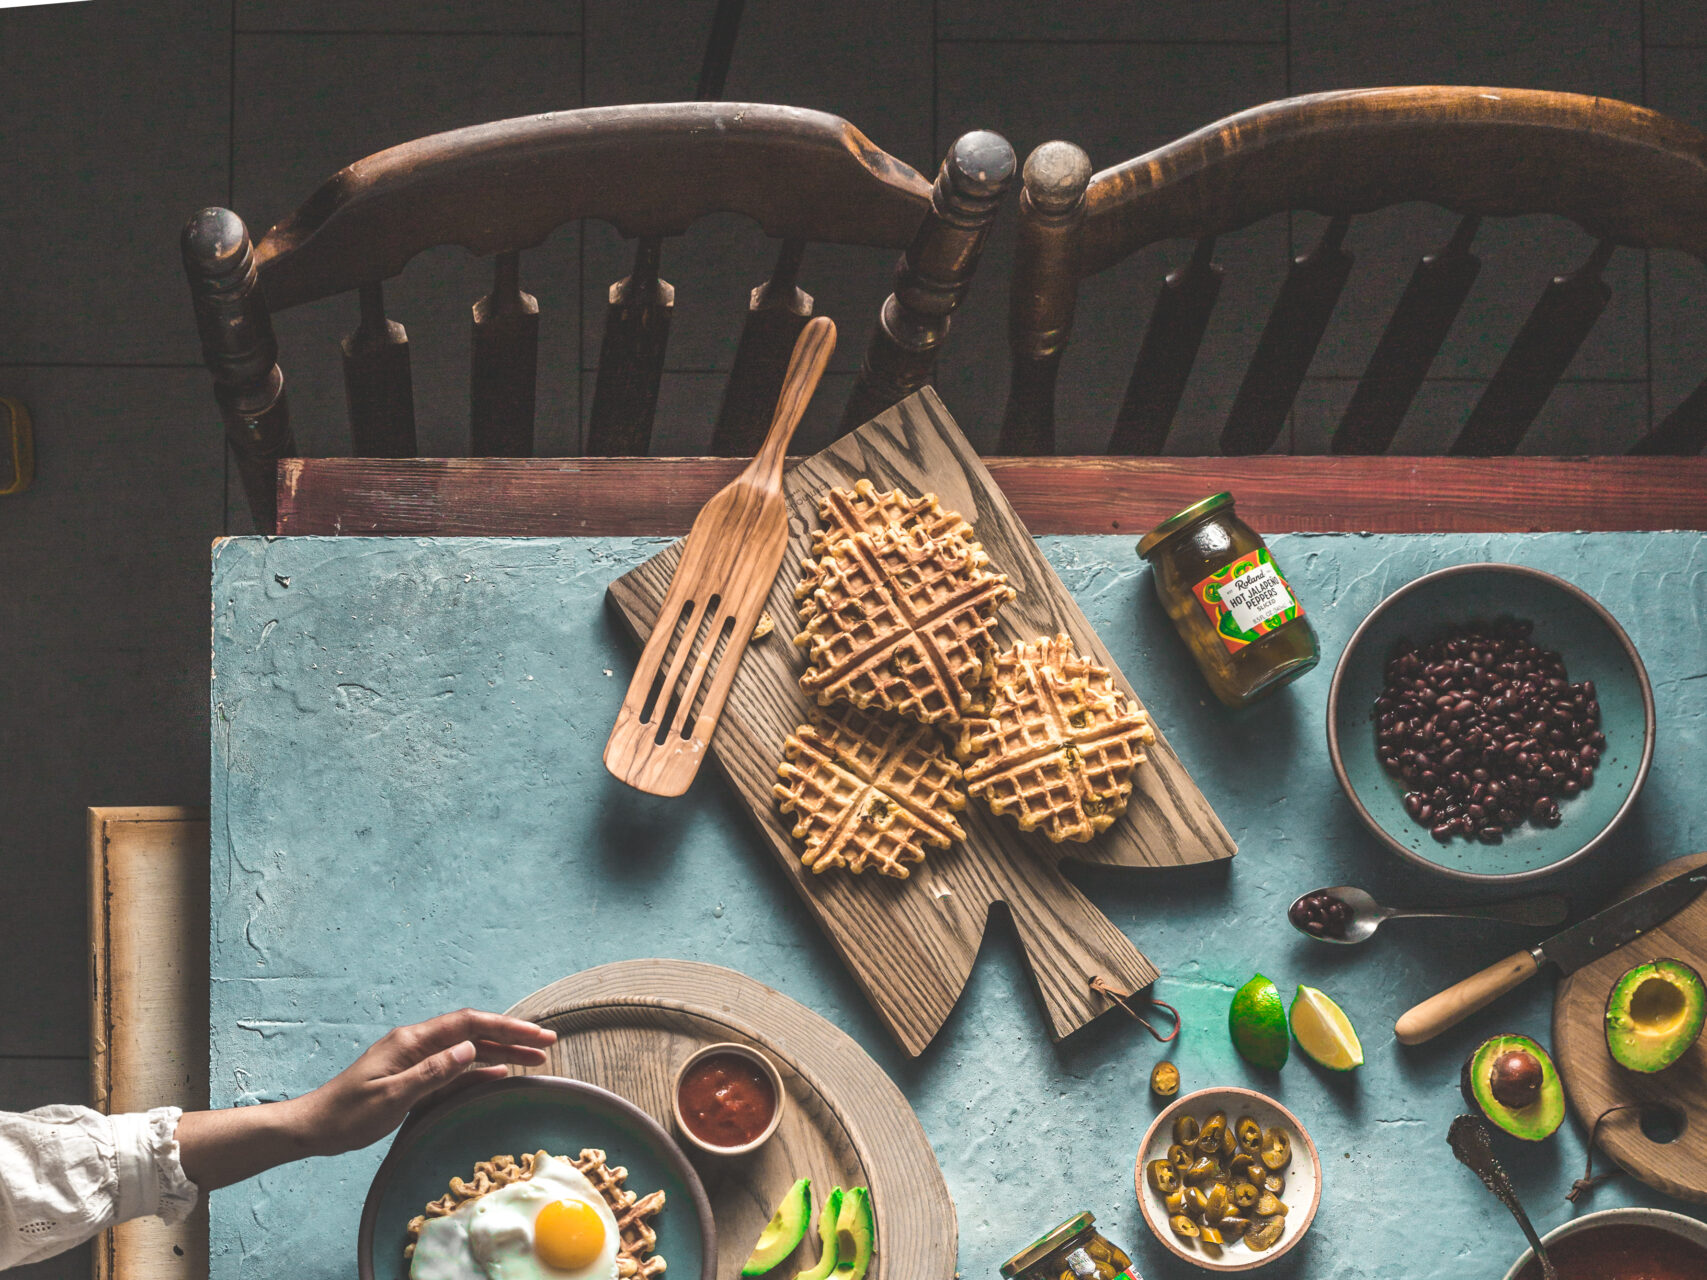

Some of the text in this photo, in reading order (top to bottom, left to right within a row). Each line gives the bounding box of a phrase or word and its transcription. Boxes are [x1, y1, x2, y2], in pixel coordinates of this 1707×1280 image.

[1235, 569, 1265, 591] Roland
[1229, 576, 1279, 608] HOT JALAPEÑO
[1245, 588, 1278, 610] PEPPERS
[1256, 599, 1276, 611] SLICED
